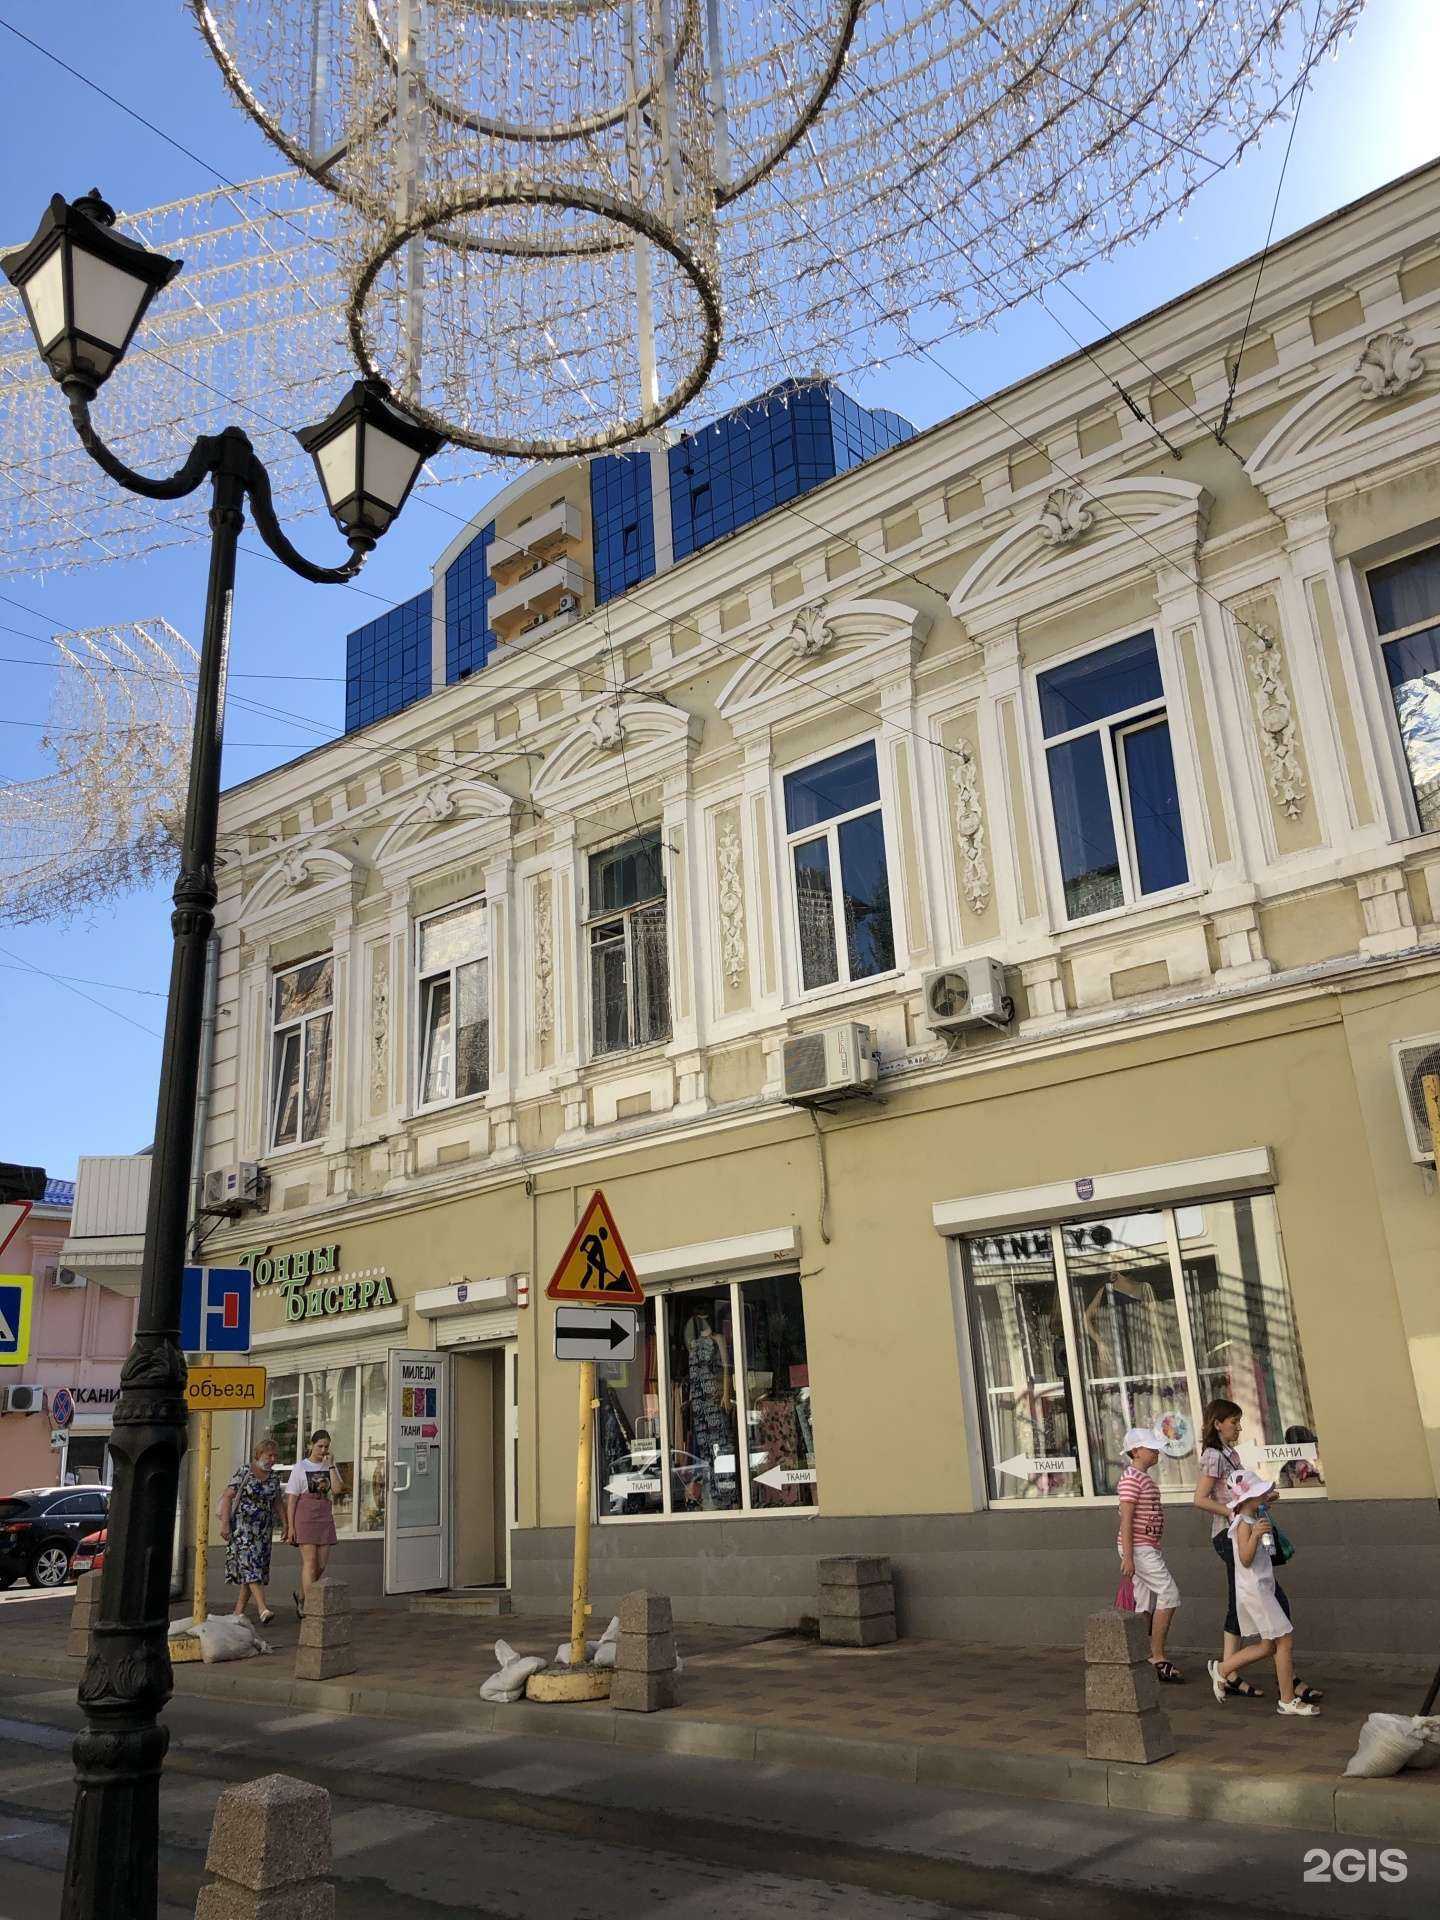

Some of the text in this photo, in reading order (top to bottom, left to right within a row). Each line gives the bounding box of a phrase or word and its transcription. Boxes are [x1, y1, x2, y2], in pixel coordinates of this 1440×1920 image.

[280, 1276, 393, 1321] БИСЕРА
[402, 1365, 436, 1381] МИЛЕДИ
[189, 1379, 255, 1398] объезд
[69, 1388, 121, 1402] ТКАНИ
[401, 1425, 421, 1437] ТКАНИ
[1264, 1447, 1302, 1458] ТКАНИ
[1034, 1461, 1064, 1470] ТКАНИ
[786, 1472, 811, 1481] ТКАНИ
[632, 1482, 653, 1491] ТКАНИ
